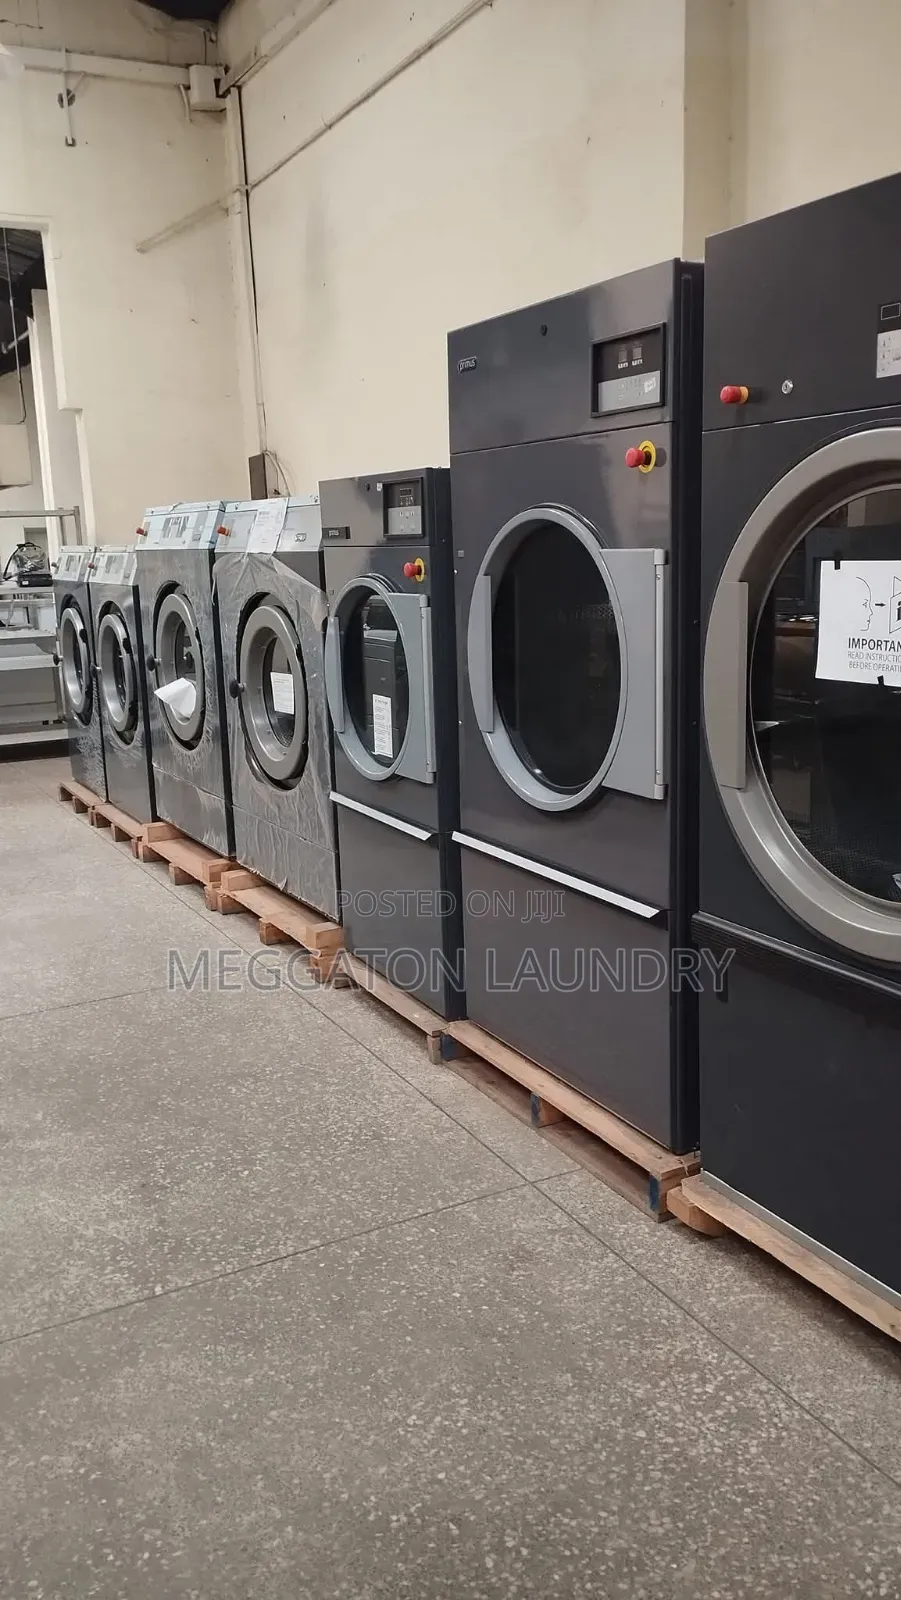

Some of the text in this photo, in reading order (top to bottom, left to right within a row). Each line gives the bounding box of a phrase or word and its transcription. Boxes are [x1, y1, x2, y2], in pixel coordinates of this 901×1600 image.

[848, 651, 865, 660] READ
[848, 660, 901, 673] BEFORE OPERATI
